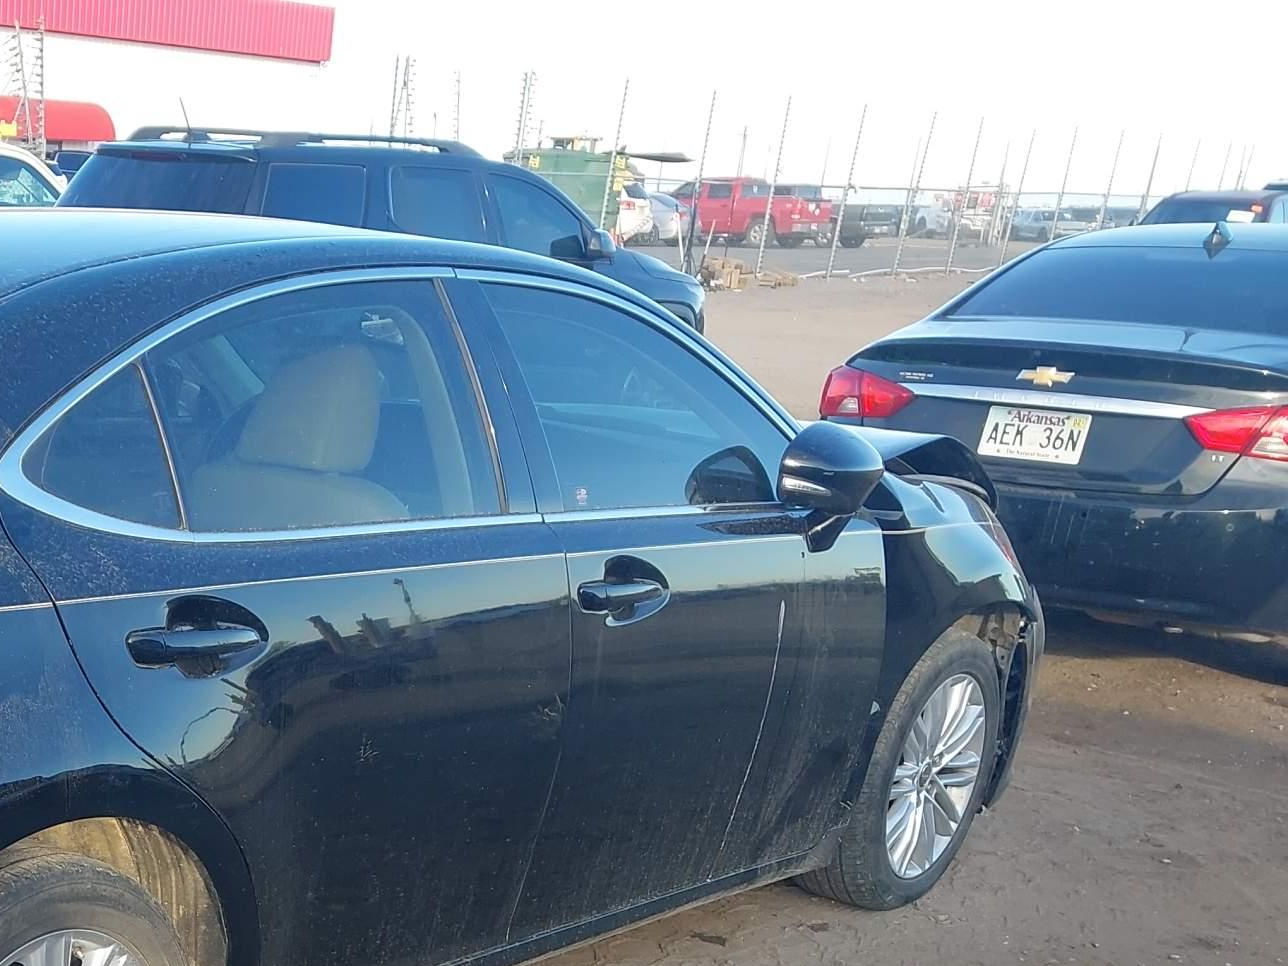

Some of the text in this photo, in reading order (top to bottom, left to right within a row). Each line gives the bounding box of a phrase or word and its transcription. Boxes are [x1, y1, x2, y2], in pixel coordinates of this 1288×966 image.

[1012, 410, 1066, 427] Arkansas
[986, 421, 1082, 452] AEK 36N
